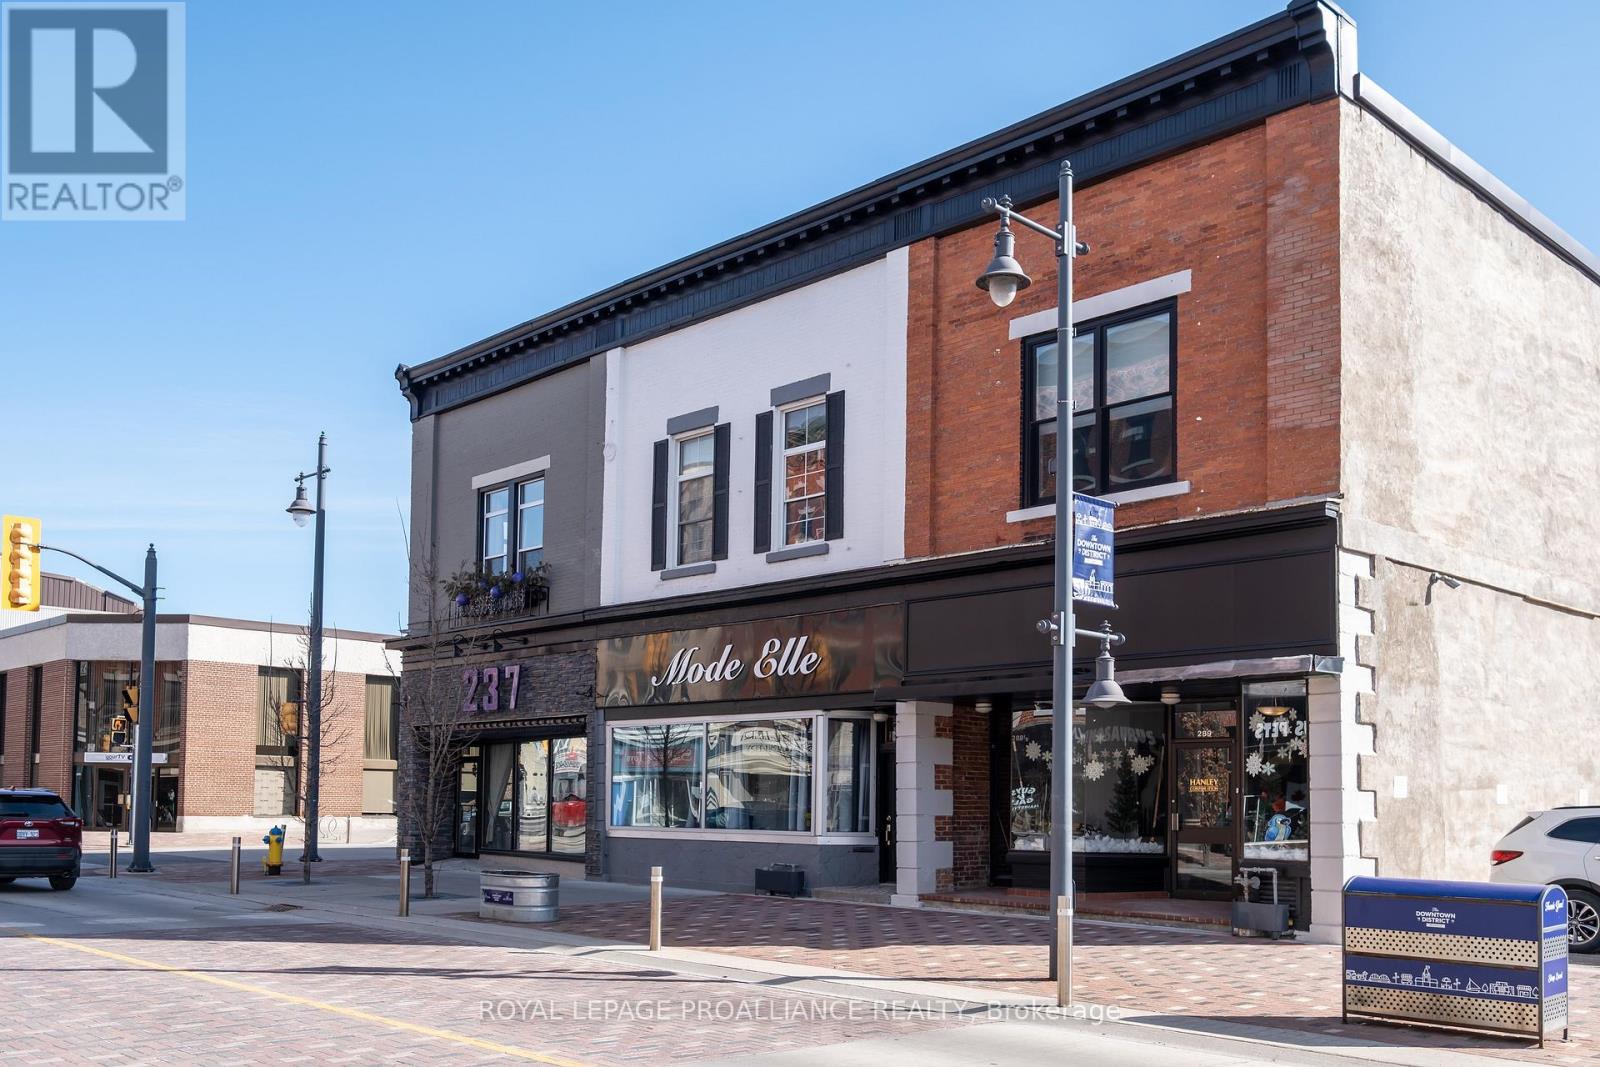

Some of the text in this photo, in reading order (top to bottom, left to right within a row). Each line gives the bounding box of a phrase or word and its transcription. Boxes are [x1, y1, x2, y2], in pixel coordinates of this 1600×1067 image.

[1077, 538, 1112, 553] DOWNTOWN
[1081, 548, 1108, 560] DISTRICT
[651, 635, 823, 687] Mode Elle
[463, 664, 521, 712] 237
[1190, 778, 1218, 786] HANLEY
[1415, 910, 1456, 919] DOWNTOWN
[1421, 916, 1450, 924] DISTRICT
